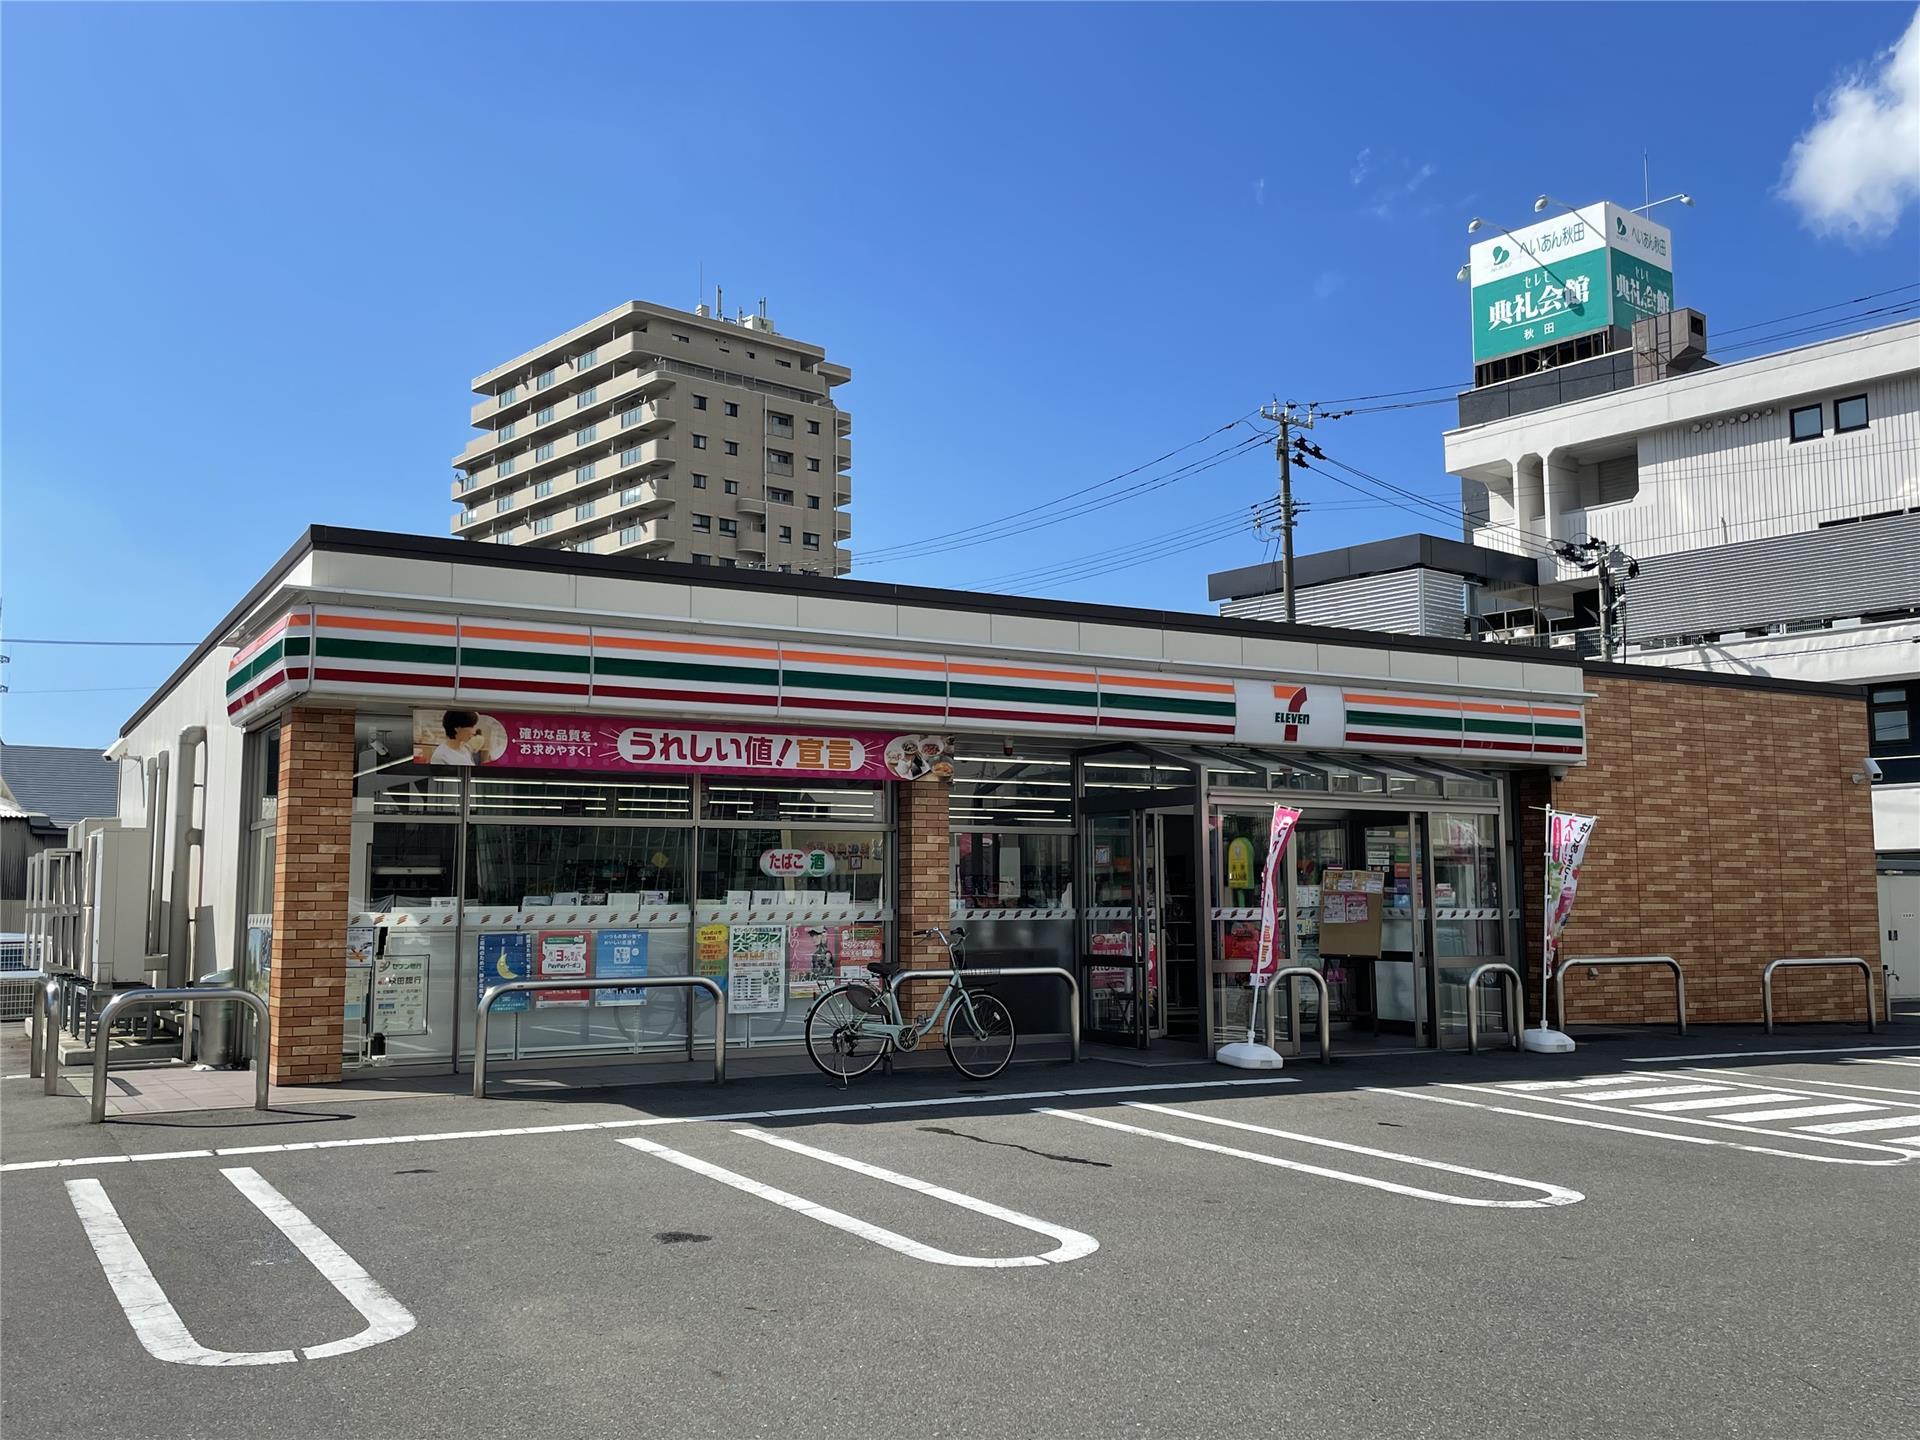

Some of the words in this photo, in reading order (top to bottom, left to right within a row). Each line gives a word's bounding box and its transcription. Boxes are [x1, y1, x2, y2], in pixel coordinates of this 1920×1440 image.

[1519, 222, 1585, 256] へいあん秋田
[1488, 275, 1590, 331] 典礼会館
[519, 727, 591, 742] 確かな品質を
[520, 744, 591, 758] お求めやすく!
[769, 853, 804, 870] たばこ
[810, 853, 825, 870] 酒
[733, 932, 782, 943] スタッフ
